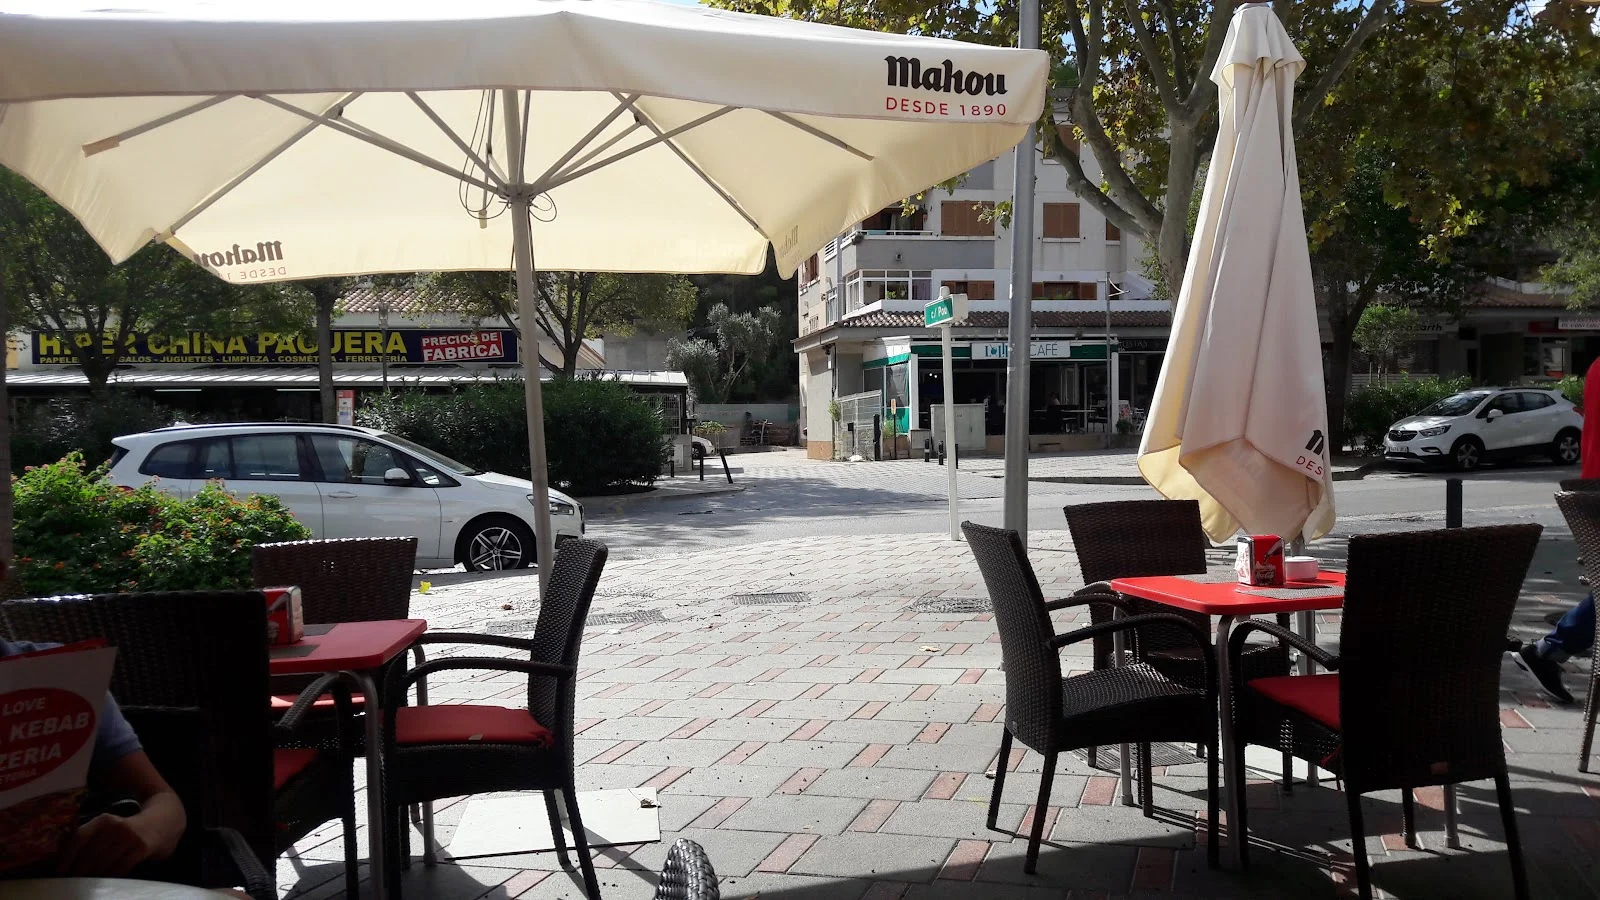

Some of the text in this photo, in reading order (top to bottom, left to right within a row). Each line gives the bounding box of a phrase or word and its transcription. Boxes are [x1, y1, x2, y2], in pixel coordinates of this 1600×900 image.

[884, 55, 1008, 96] Mahou
[886, 97, 1007, 116] DESDE 1890
[39, 332, 138, 355] HPER
[147, 331, 248, 355] CHINA
[422, 332, 498, 347] PRECIOS DE
[39, 356, 80, 364] PAPELE
[277, 354, 337, 362] COSMÉTA
[423, 344, 501, 361] FABRICA
[1295, 455, 1324, 480] DES
[2, 696, 46, 717] LOVE
[9, 712, 90, 742] KEBAB
